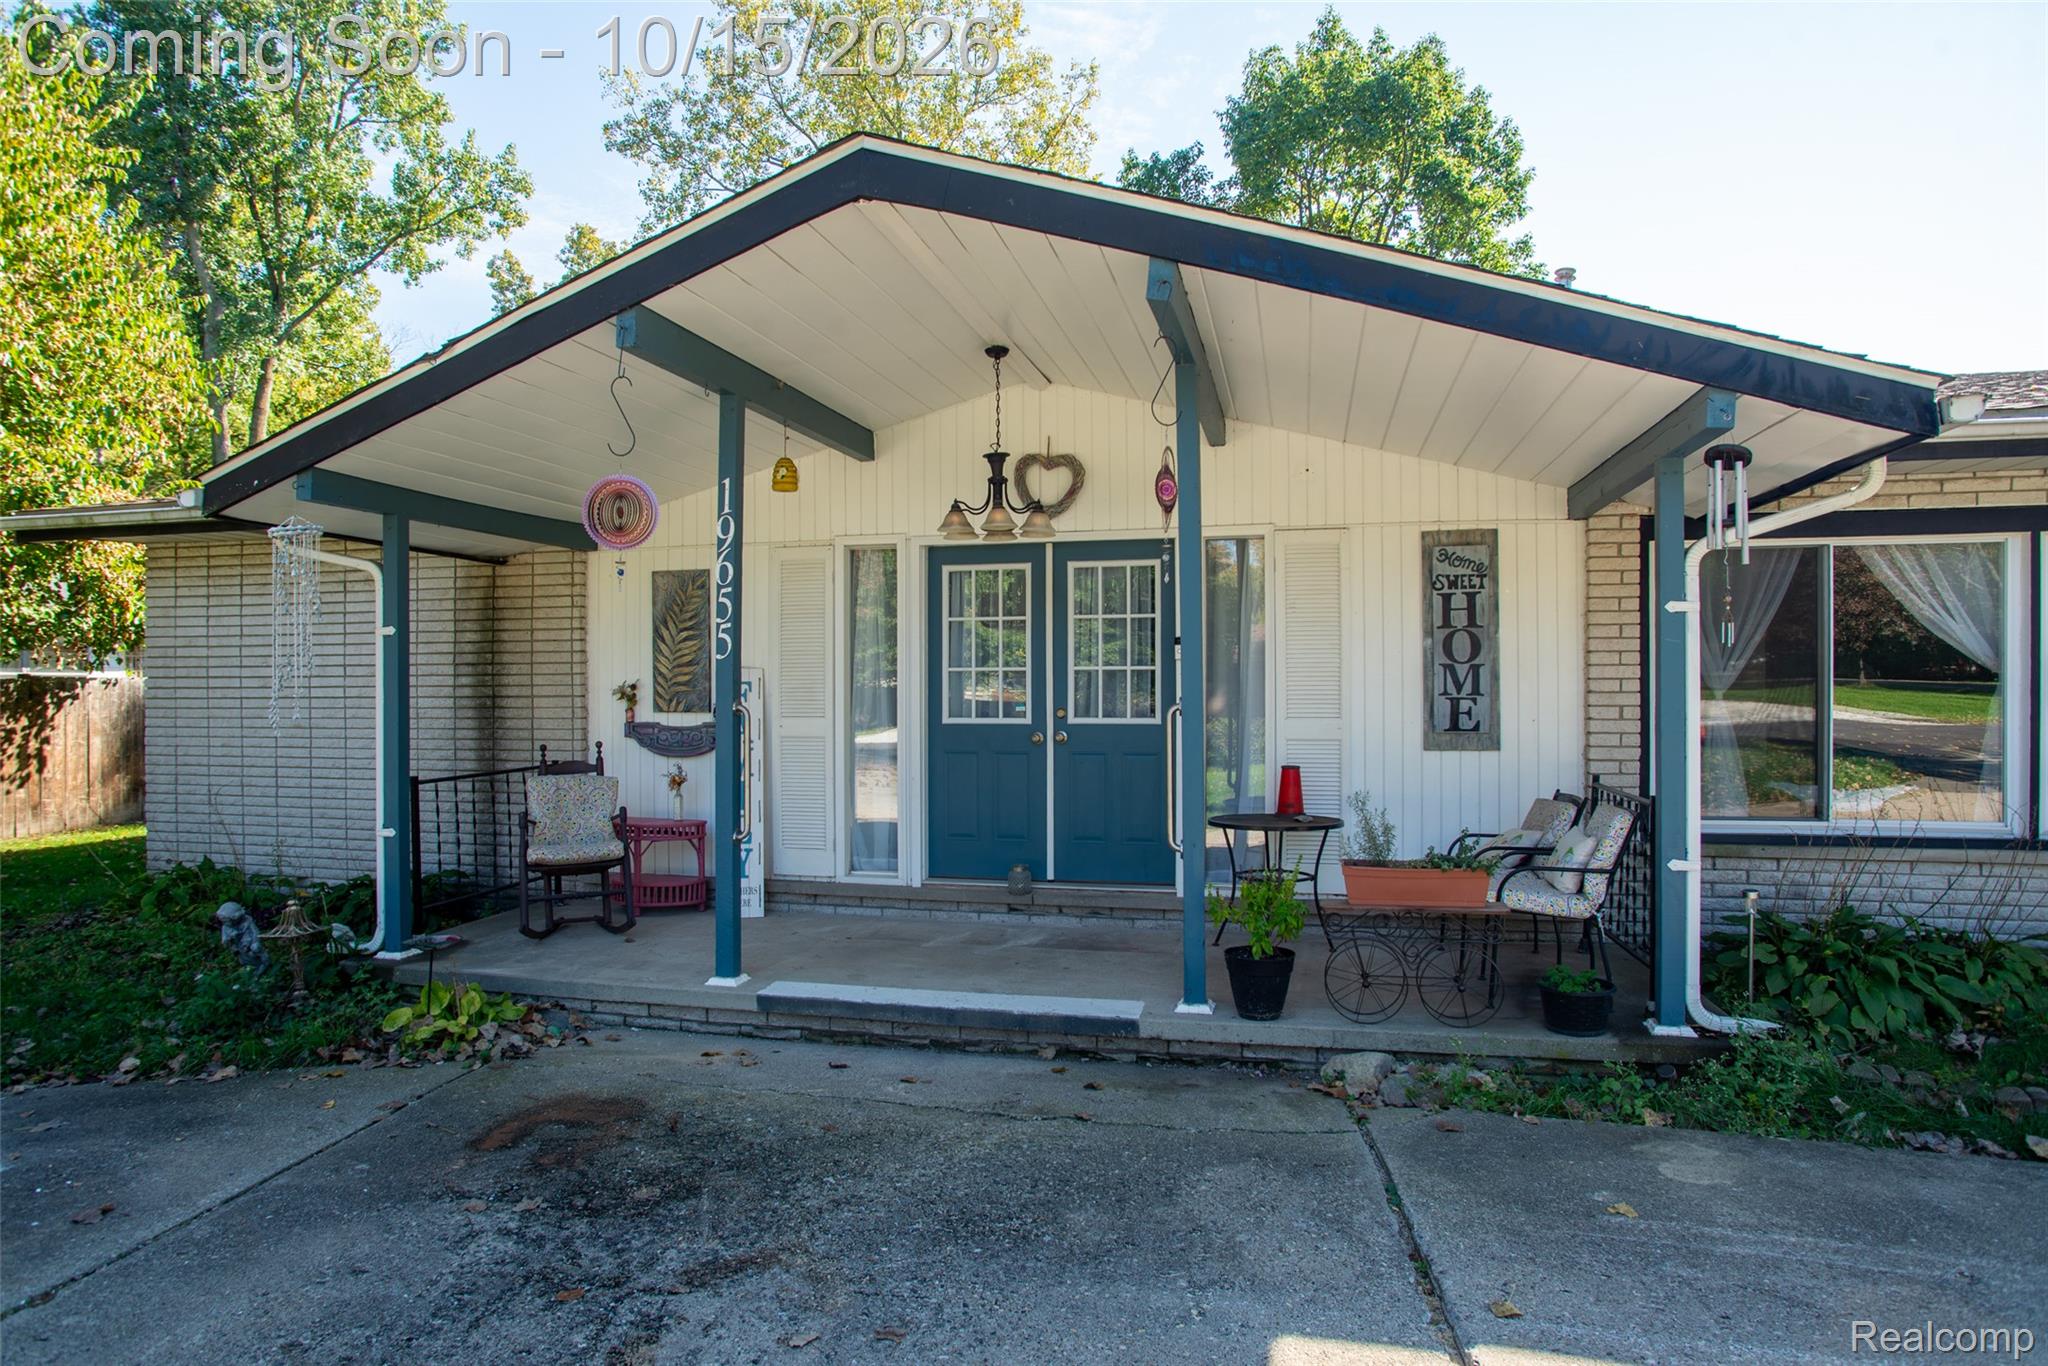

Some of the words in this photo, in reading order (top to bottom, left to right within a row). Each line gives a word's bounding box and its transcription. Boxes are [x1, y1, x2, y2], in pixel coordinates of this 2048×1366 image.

[715, 477, 735, 660] 19655
[1432, 574, 1487, 591] SWEET
[1436, 548, 1488, 574] Home
[1436, 591, 1485, 732] HOME
